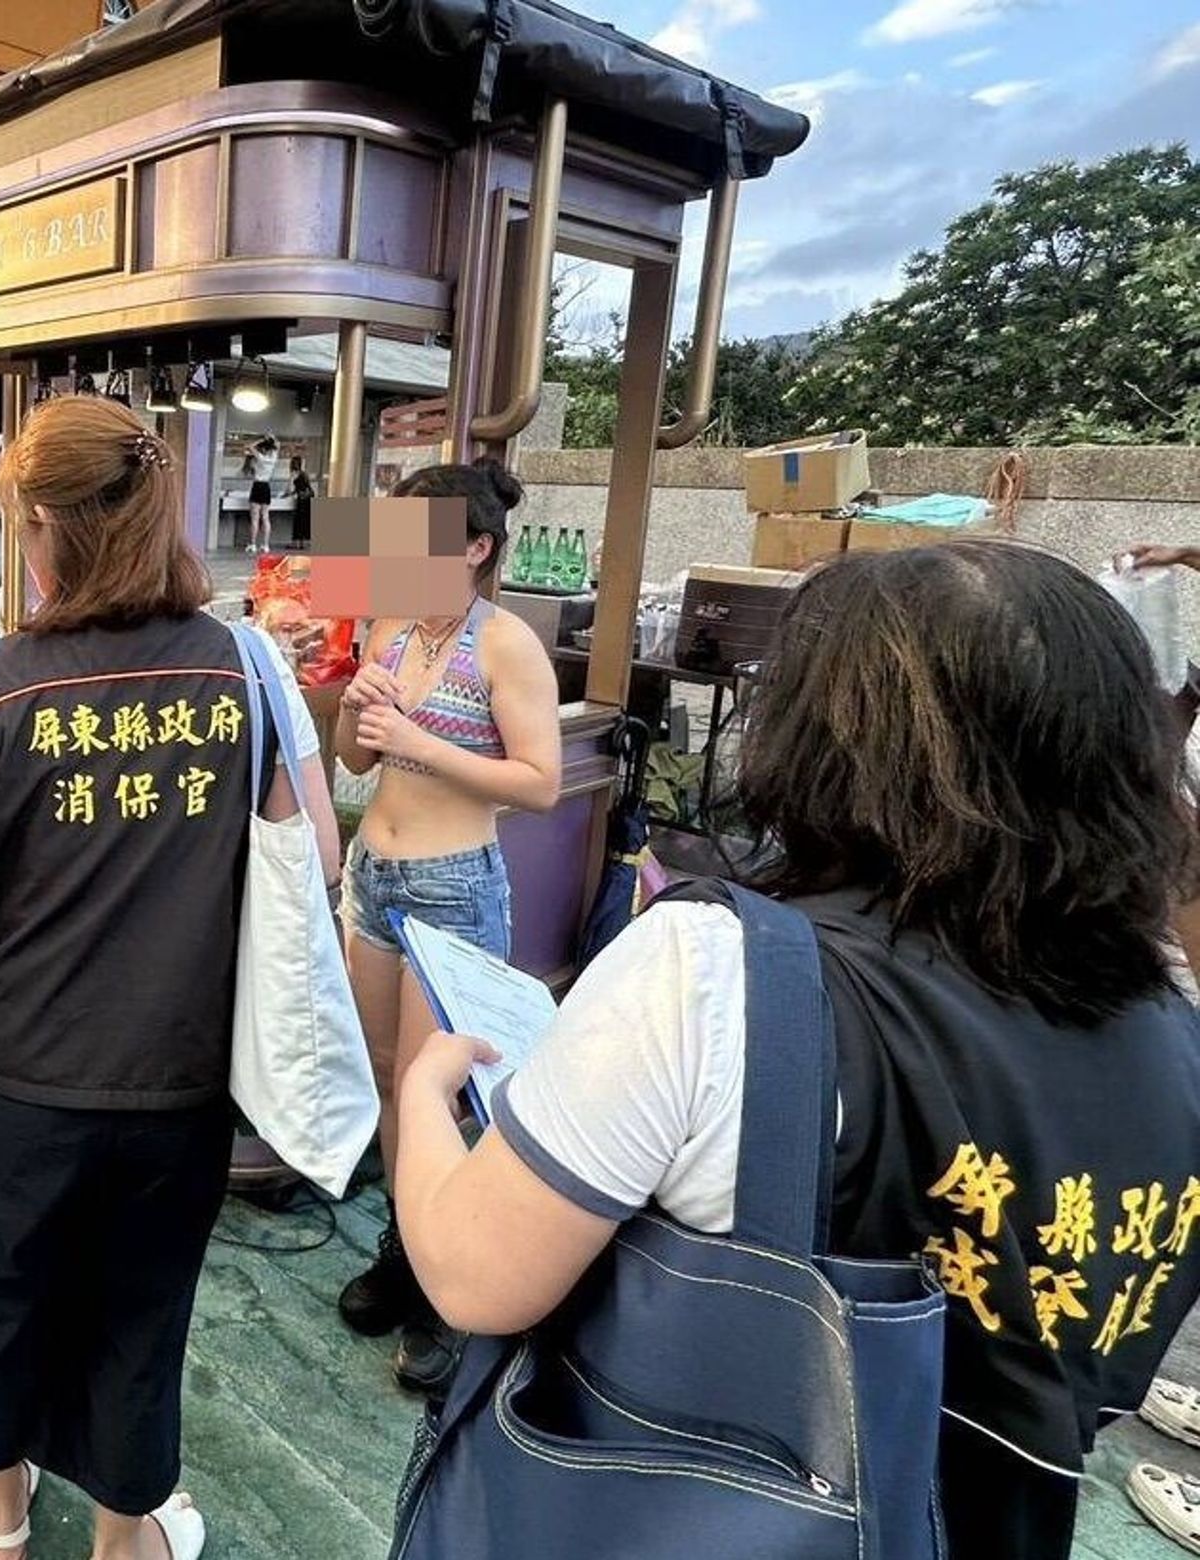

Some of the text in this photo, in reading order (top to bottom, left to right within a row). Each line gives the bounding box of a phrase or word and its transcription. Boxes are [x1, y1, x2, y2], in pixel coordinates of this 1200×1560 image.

[28, 694, 244, 759] 屏東縣政府
[53, 766, 217, 825] 消保官
